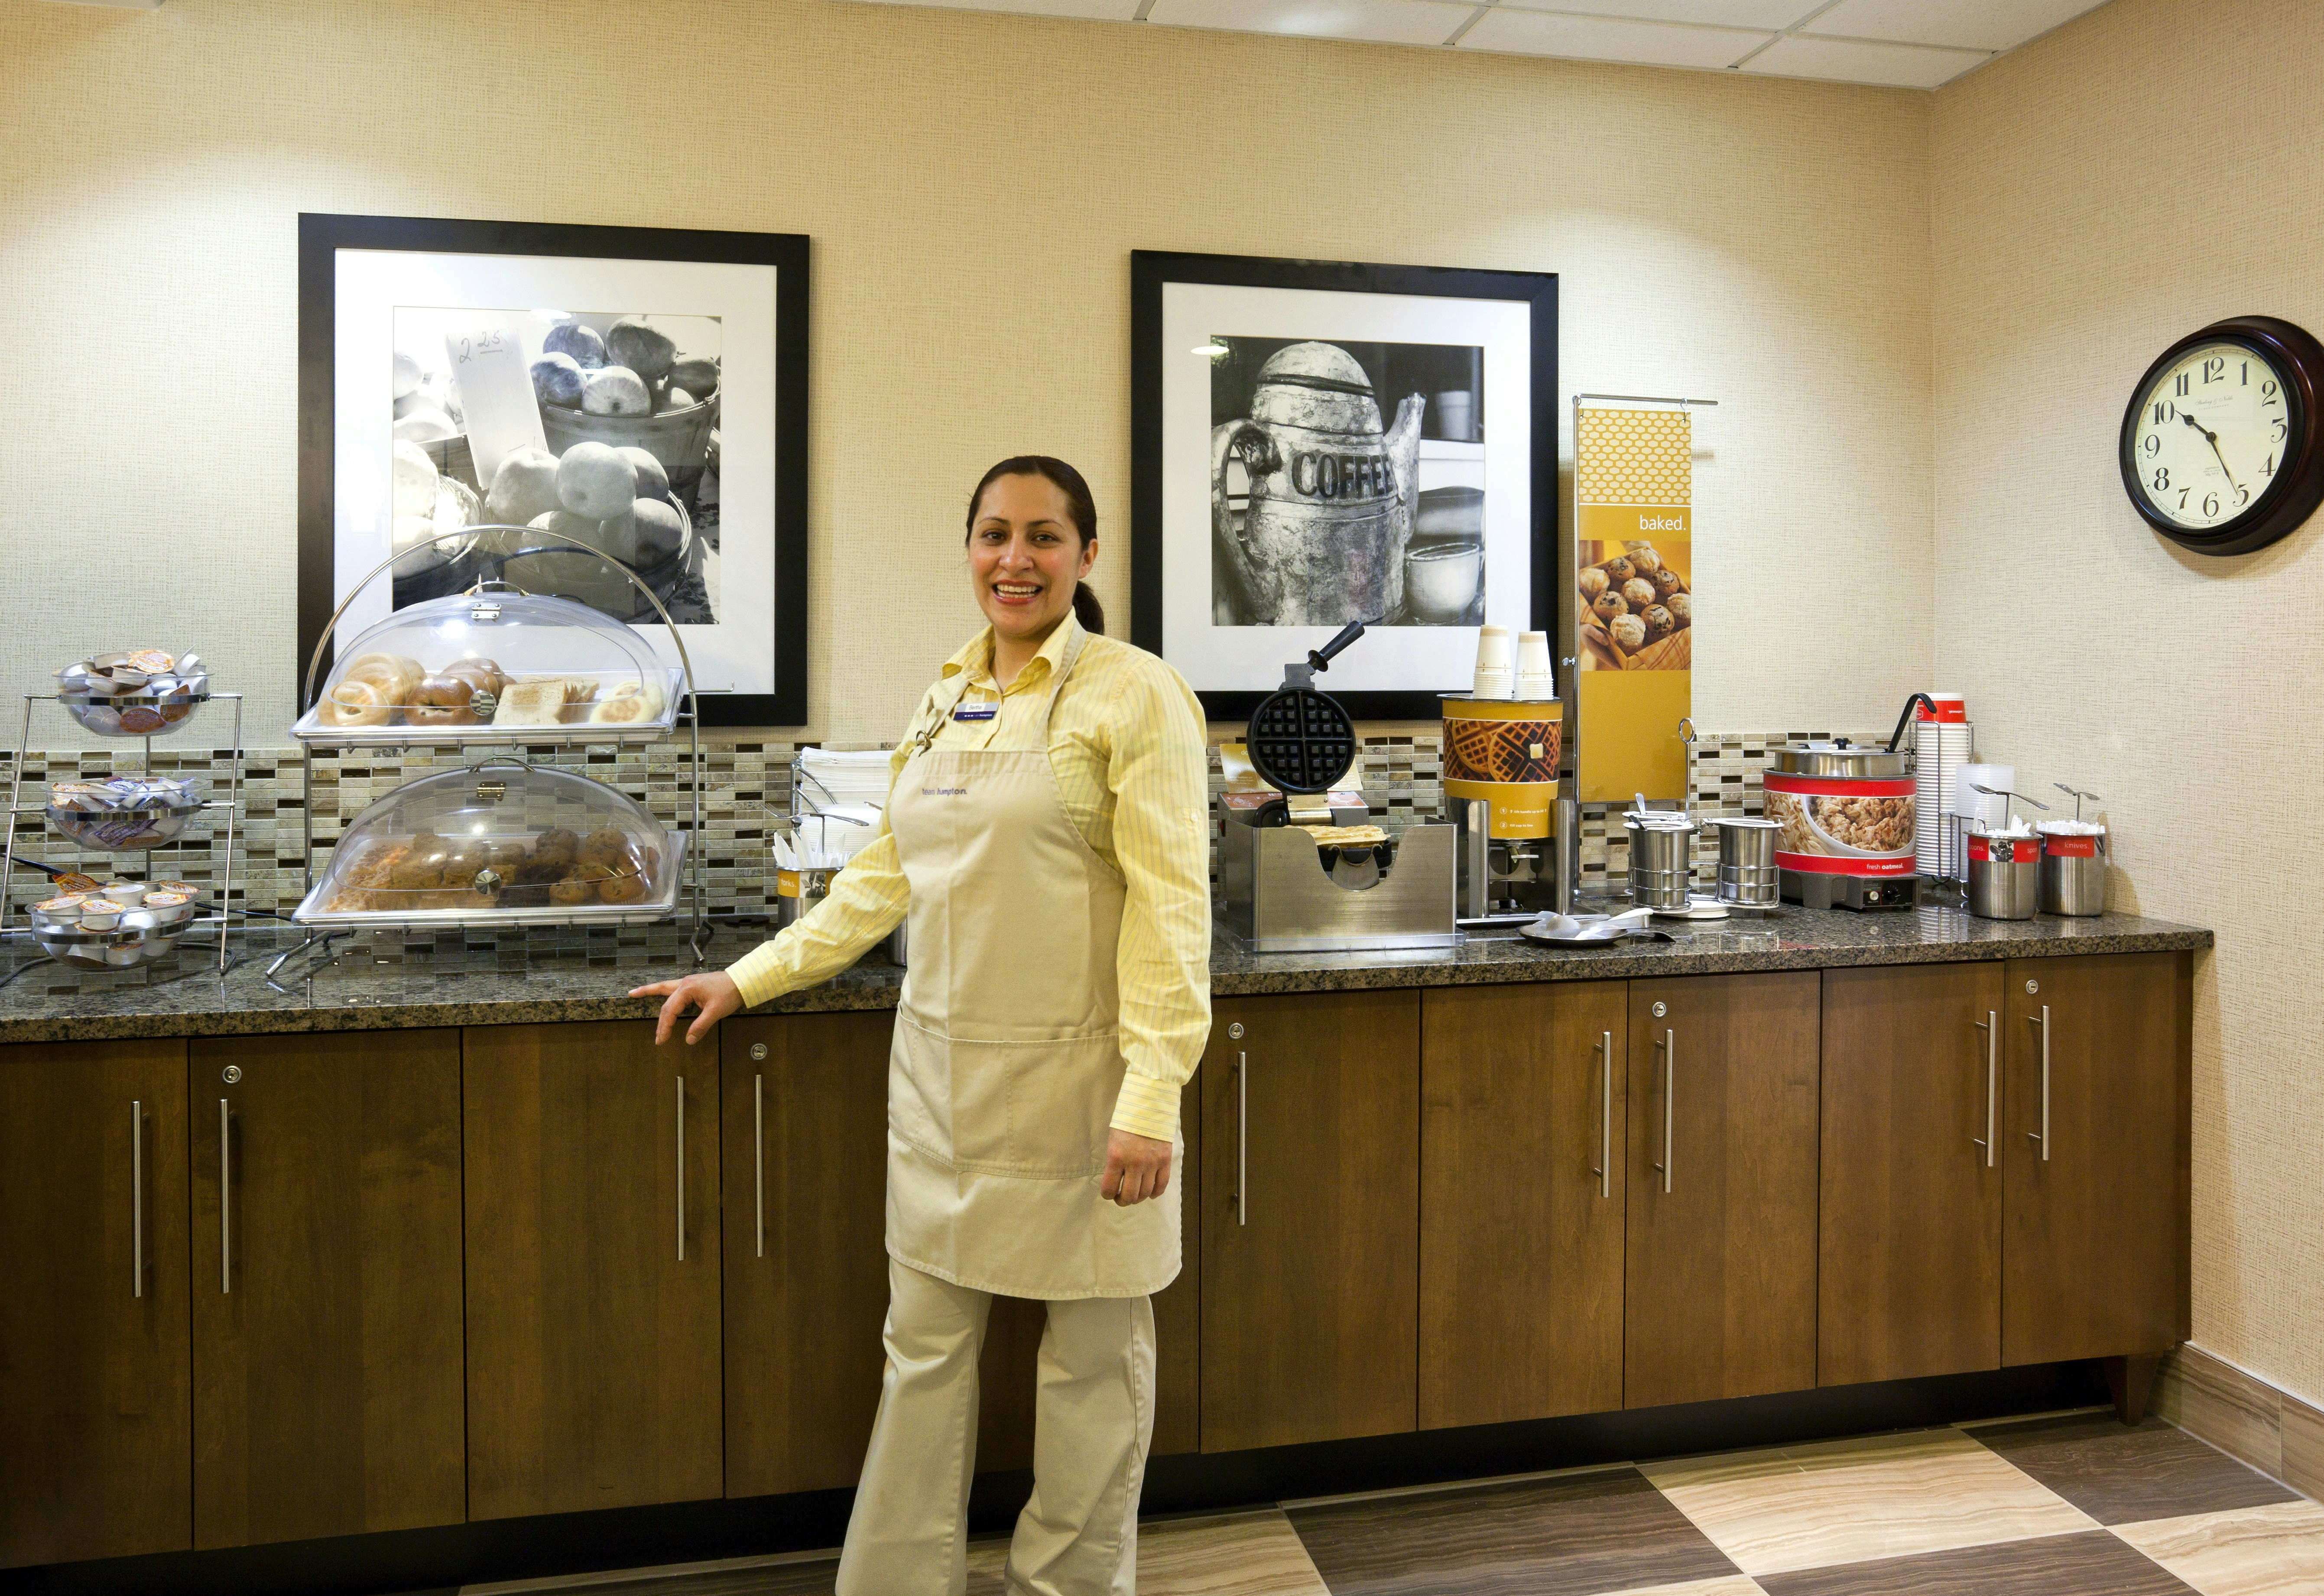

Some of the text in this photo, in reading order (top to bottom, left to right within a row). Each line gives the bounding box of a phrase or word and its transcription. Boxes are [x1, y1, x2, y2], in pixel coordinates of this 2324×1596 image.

[2202, 357, 2225, 384] 12
[2240, 360, 2249, 386] 1
[2175, 372, 2190, 397] 11
[2262, 380, 2276, 407] 2
[2153, 400, 2175, 425] 10
[2270, 417, 2288, 443] 3
[2145, 434, 2160, 459] 9
[1292, 452, 1392, 498] COFFEE
[2258, 451, 2276, 477] 4
[2154, 467, 2169, 491] 8
[2178, 487, 2191, 510] 7
[2203, 492, 2219, 517] 6
[2233, 483, 2249, 507] 5
[1640, 514, 1686, 530] baked.
[937, 788, 967, 796] hampton.
[781, 878, 797, 888] forks.
